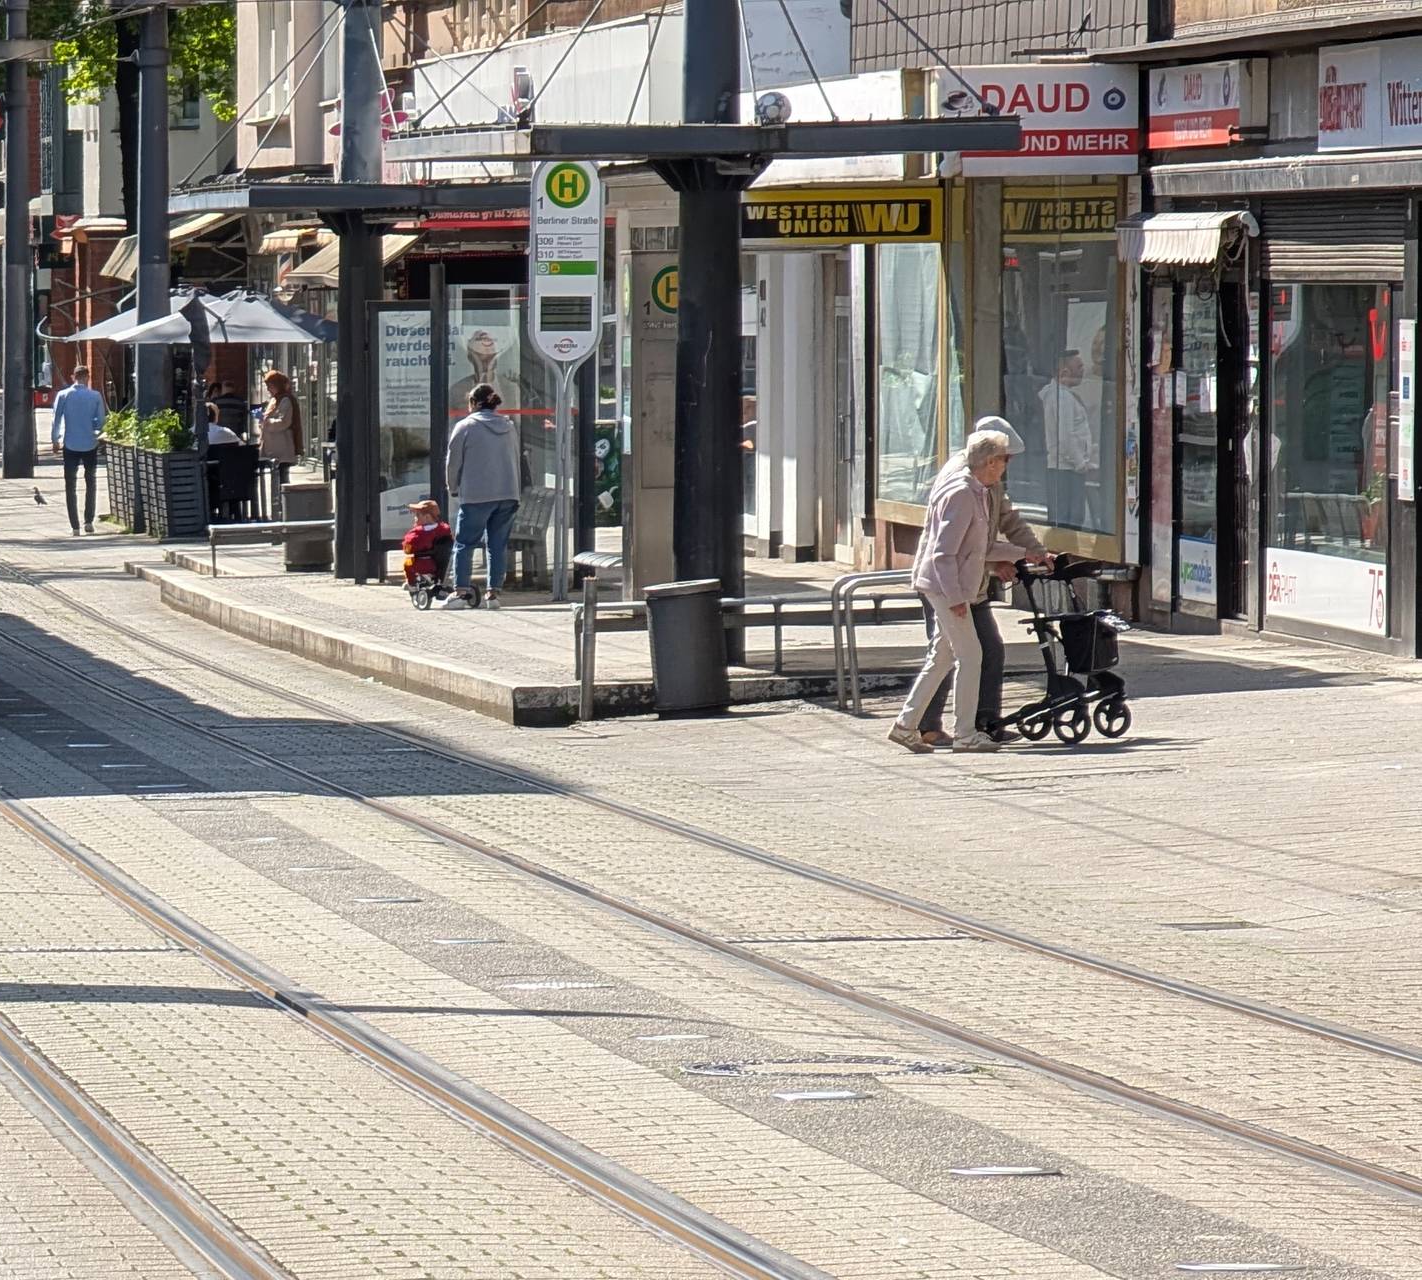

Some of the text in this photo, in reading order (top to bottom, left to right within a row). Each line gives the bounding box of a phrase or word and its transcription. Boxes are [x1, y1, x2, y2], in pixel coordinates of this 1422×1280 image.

[981, 83, 1090, 113] DAUD
[1066, 134, 1129, 151] MEHR
[537, 196, 544, 210] 1
[746, 204, 849, 220] WESTERN
[860, 203, 920, 232] WU
[537, 216, 599, 225] Berliner Straße
[778, 219, 849, 233] UNION
[538, 237, 554, 246] 309
[537, 250, 554, 259] 310
[643, 301, 651, 315] 1
[1368, 568, 1385, 629] 75
